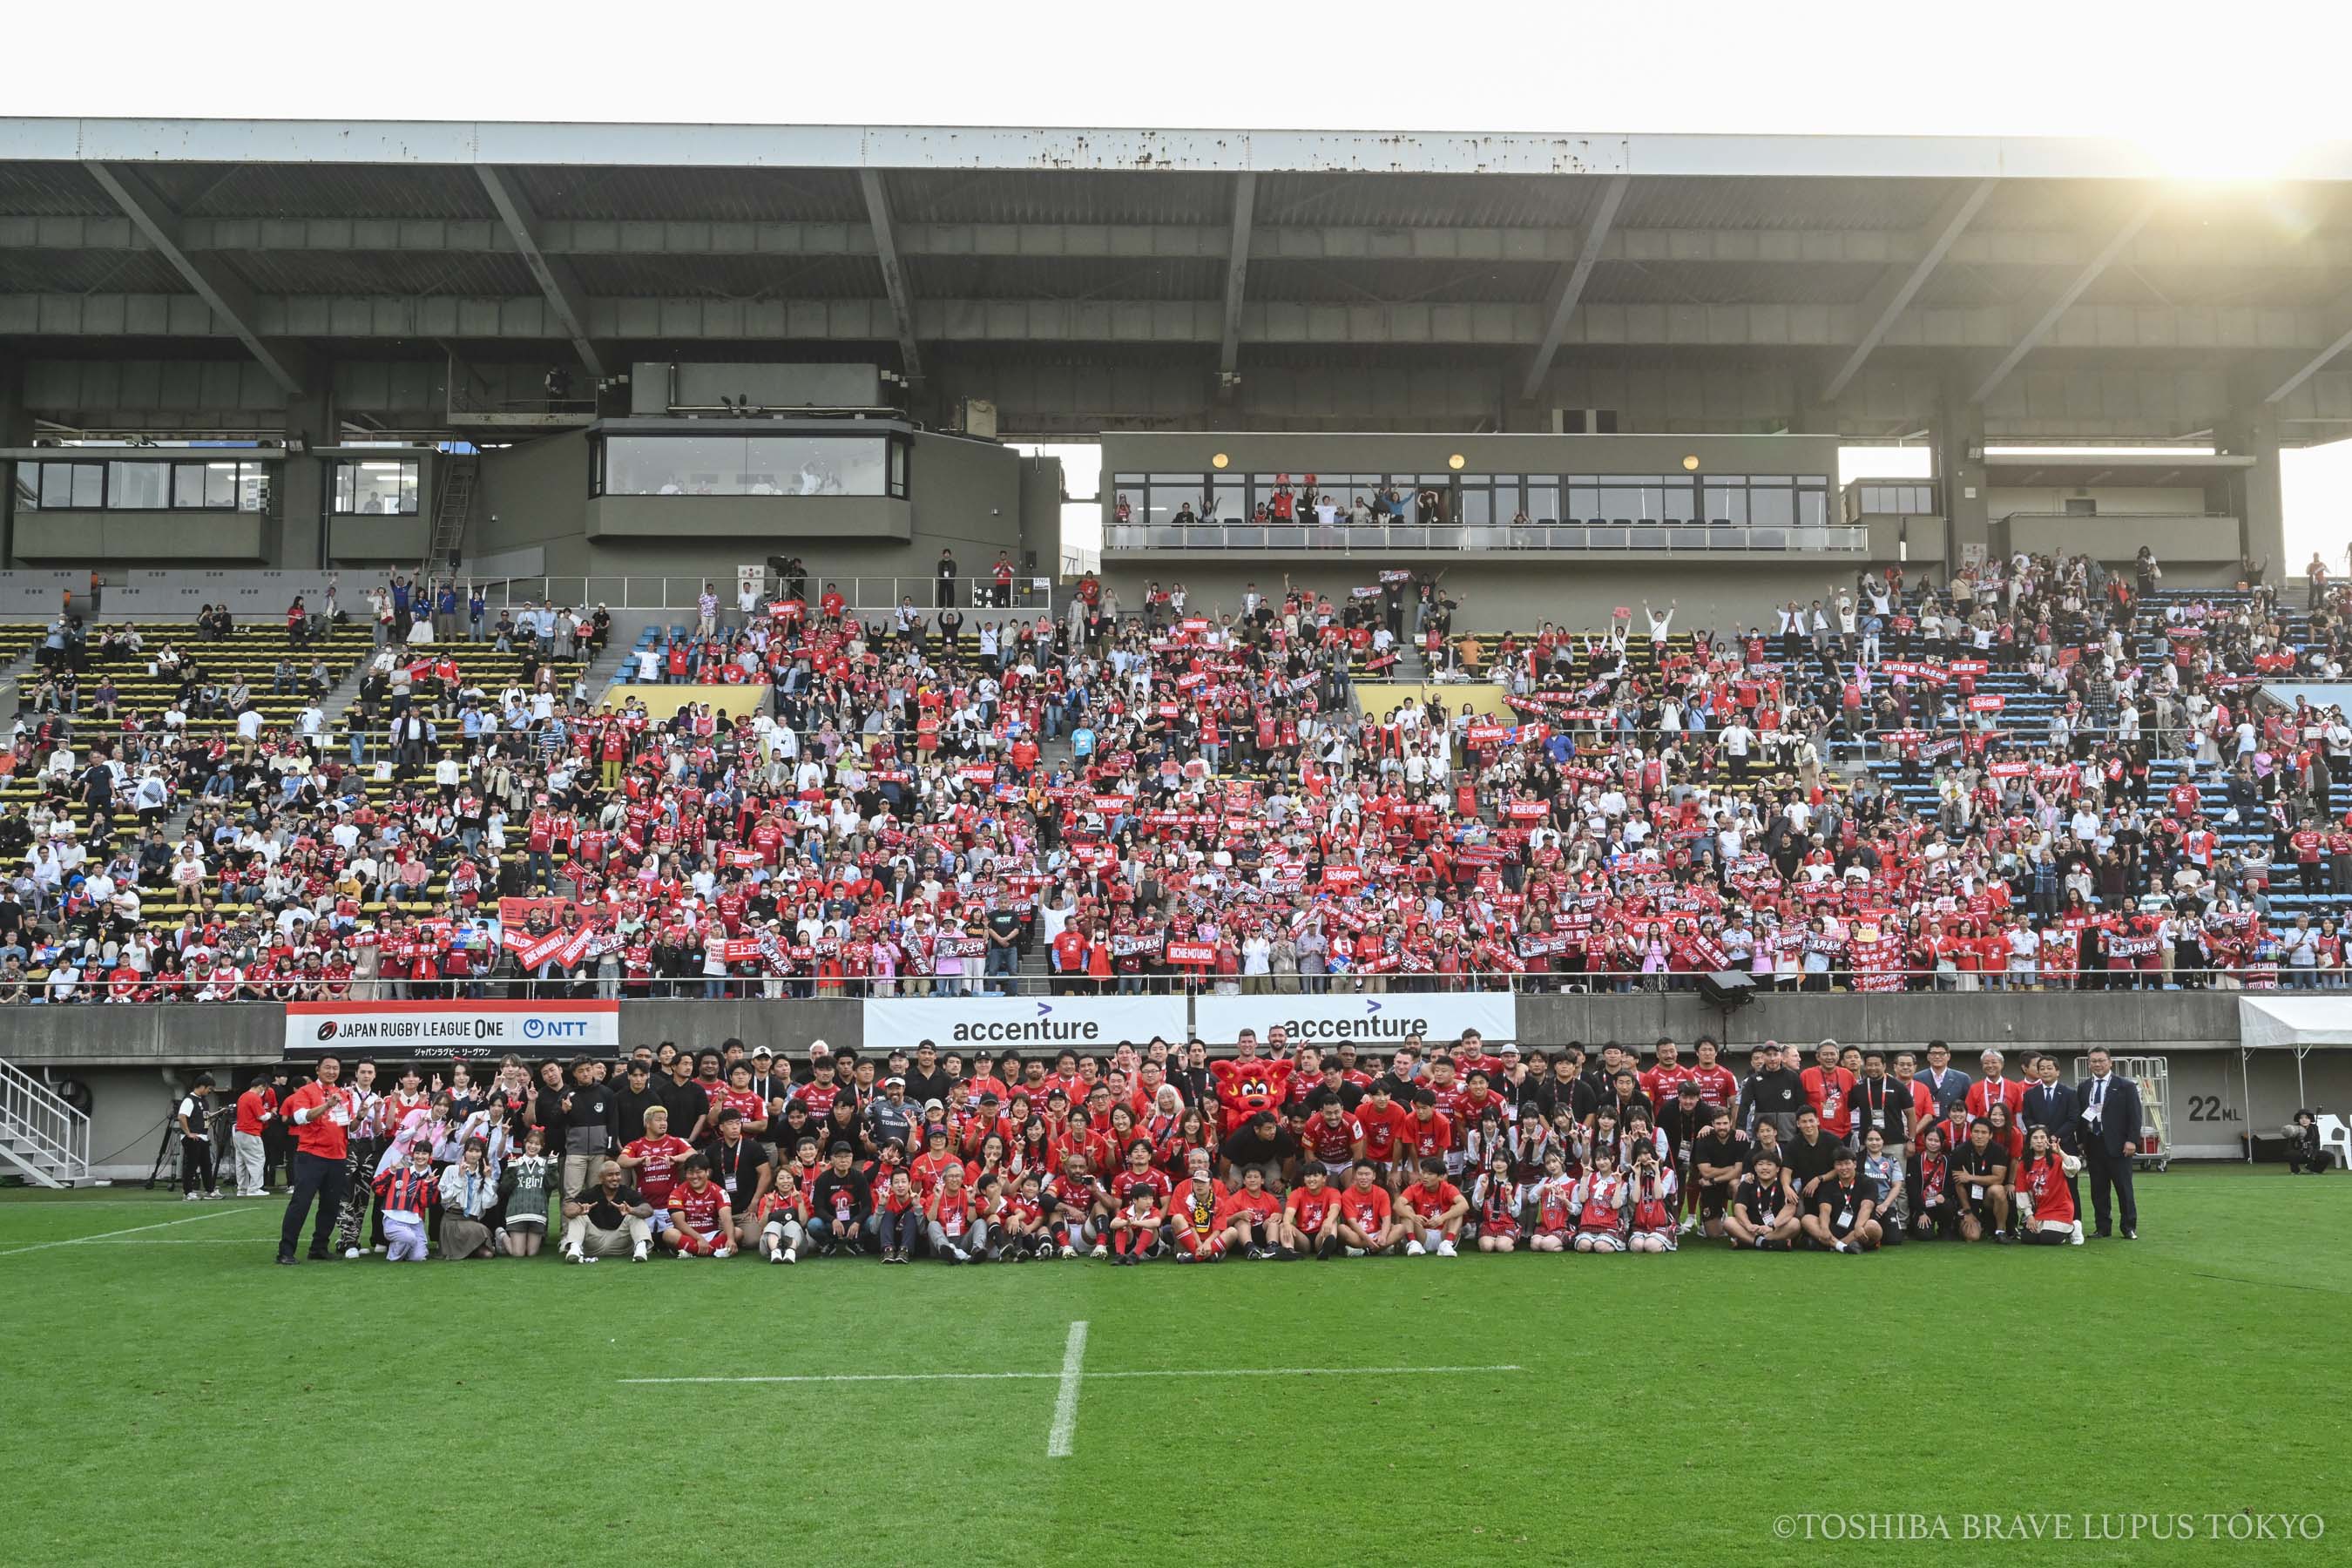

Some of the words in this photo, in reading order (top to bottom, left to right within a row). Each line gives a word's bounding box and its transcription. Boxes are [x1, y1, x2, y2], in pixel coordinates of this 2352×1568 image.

[587, 830, 609, 840] リーチ
[1554, 915, 1571, 923] 松永
[1558, 930, 1573, 939] 小川
[535, 934, 564, 956] NAIKABUL
[815, 942, 837, 957] 佐々木
[1170, 948, 1189, 959] RICHIE
[1189, 949, 1212, 960] MO'UNGA
[1860, 951, 1889, 962] 佐々木
[339, 1024, 377, 1038] JAPAN
[381, 1023, 420, 1037] RUGBY
[423, 1021, 470, 1037] LEAGUE
[475, 1018, 504, 1039] ONE
[548, 1021, 587, 1037] NTT
[953, 1017, 1098, 1041] accenture
[1284, 1015, 1428, 1038] accenture
[414, 1048, 460, 1057] ジャパンラグビー
[462, 1047, 491, 1057] リーグワン
[2188, 1096, 2220, 1122] 22
[517, 1176, 543, 1190] X-girl
[835, 1197, 848, 1207] 10
